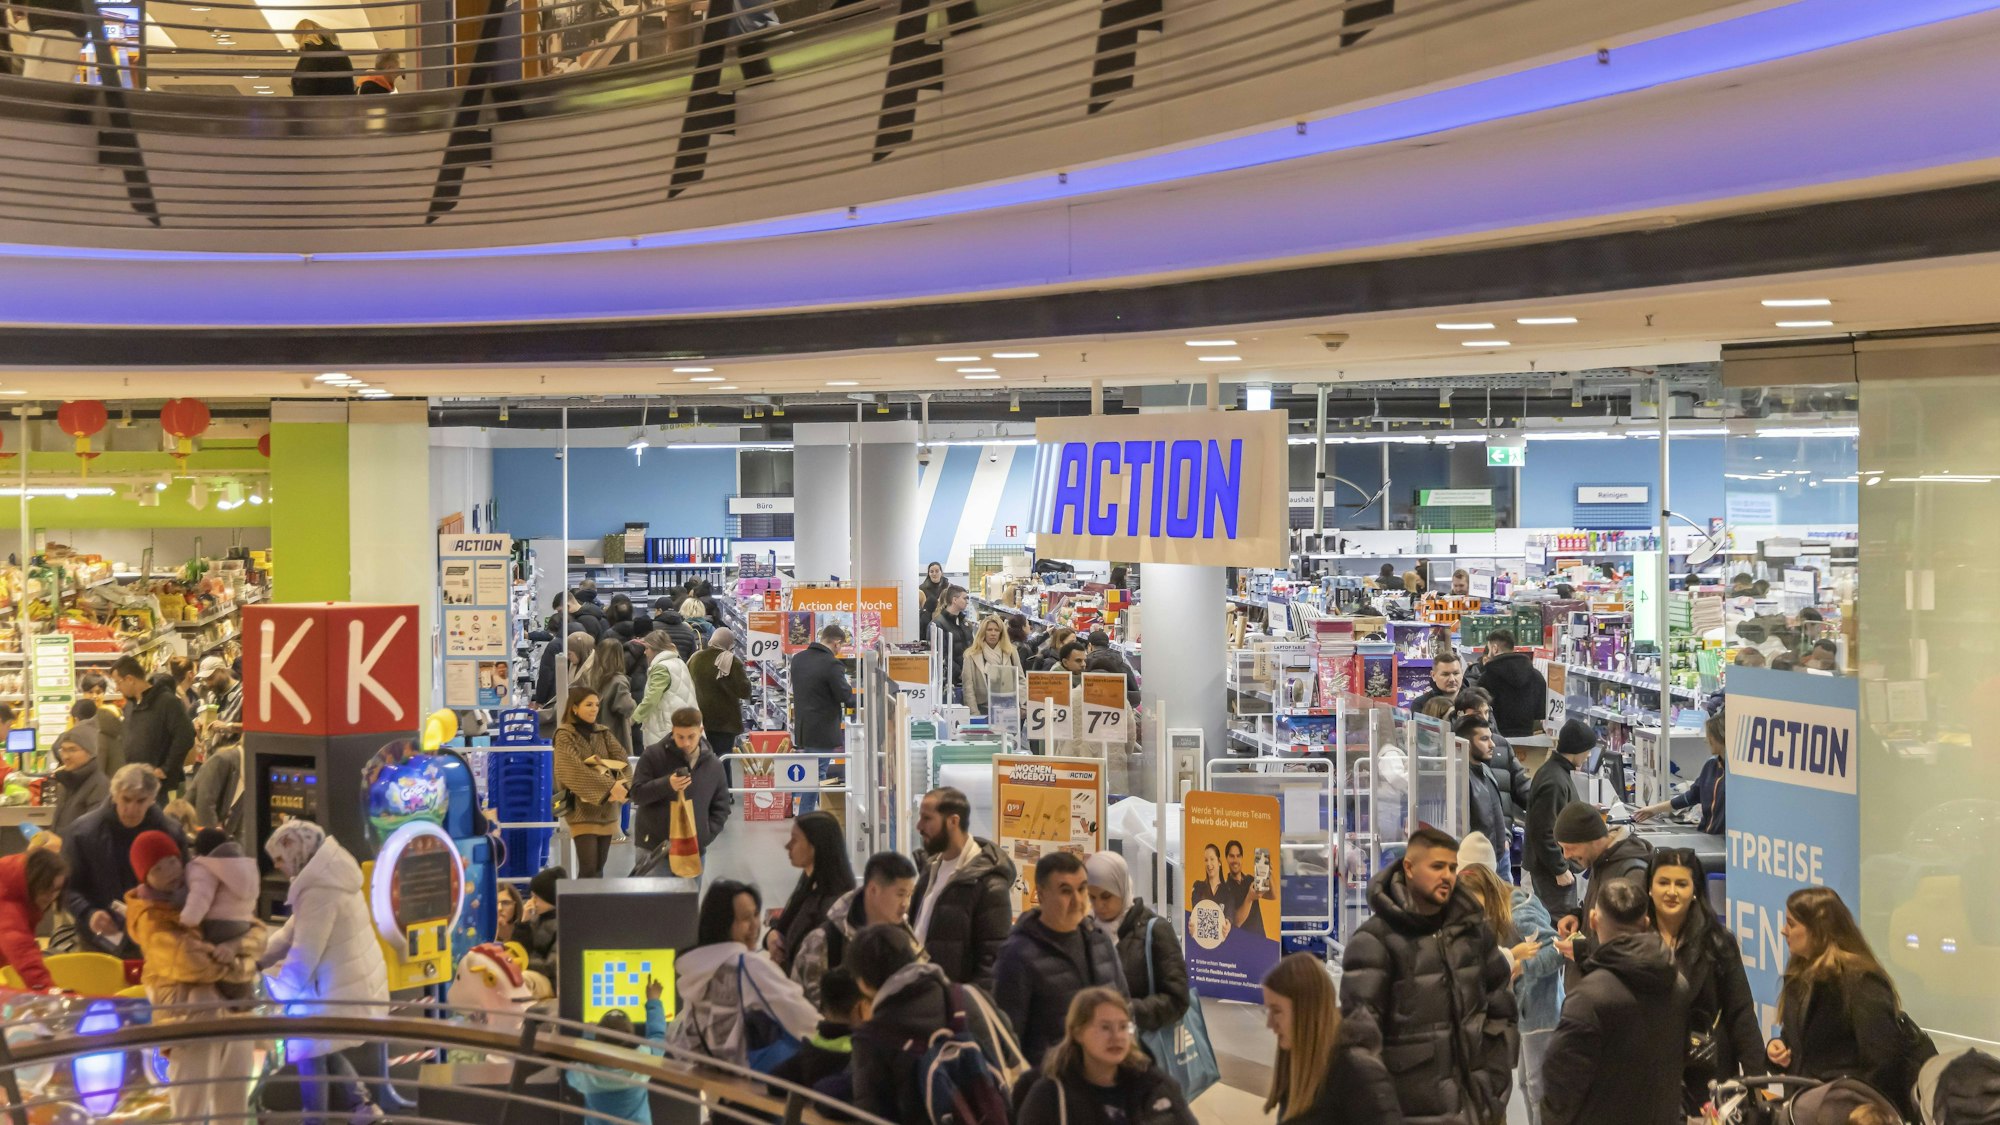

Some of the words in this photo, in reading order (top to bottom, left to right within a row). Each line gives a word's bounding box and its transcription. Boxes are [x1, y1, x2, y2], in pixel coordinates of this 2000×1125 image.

[1051, 439, 1243, 540] ACTION
[1598, 491, 1628, 499] Reinigen
[454, 540, 503, 552] ACTION
[798, 601, 833, 611] Action
[835, 601, 854, 611] der
[259, 617, 314, 725] K
[347, 615, 407, 724] K
[1031, 708, 1067, 731] 99
[1087, 710, 1120, 734] 779
[1747, 716, 1849, 778] ACTION
[1009, 771, 1056, 782] ANGEBOTE
[1014, 764, 1052, 774] WOCHEN
[1191, 806, 1211, 814] Werde
[1213, 807, 1224, 815] Teil
[1225, 809, 1250, 818] unseres
[1251, 811, 1271, 820] Teams
[1191, 816, 1214, 825] Bewirb
[1215, 818, 1229, 827] dich
[1230, 819, 1248, 828] jetzt!
[1726, 829, 1824, 886] TPREISE
